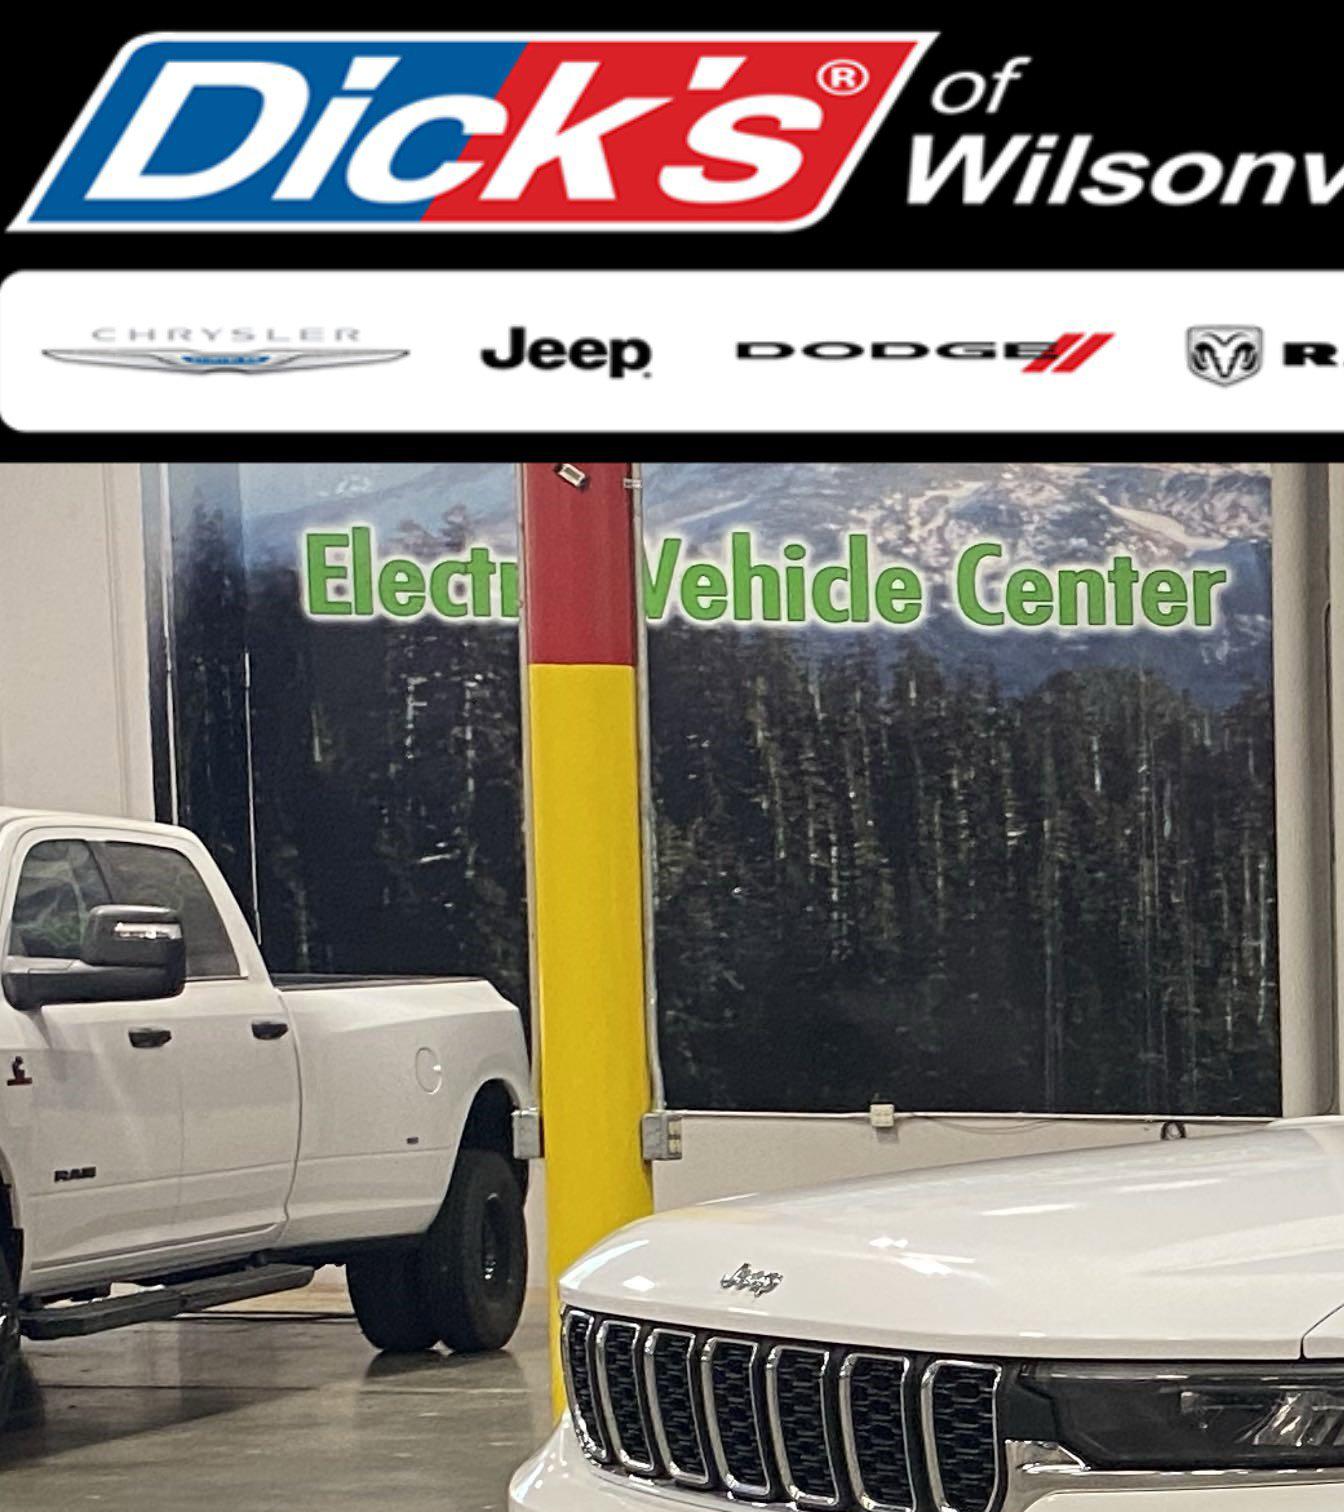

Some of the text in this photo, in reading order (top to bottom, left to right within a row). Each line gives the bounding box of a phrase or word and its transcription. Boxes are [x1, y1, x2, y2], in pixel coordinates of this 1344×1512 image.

[306, 526, 1227, 626] Electr Vehicle Center
